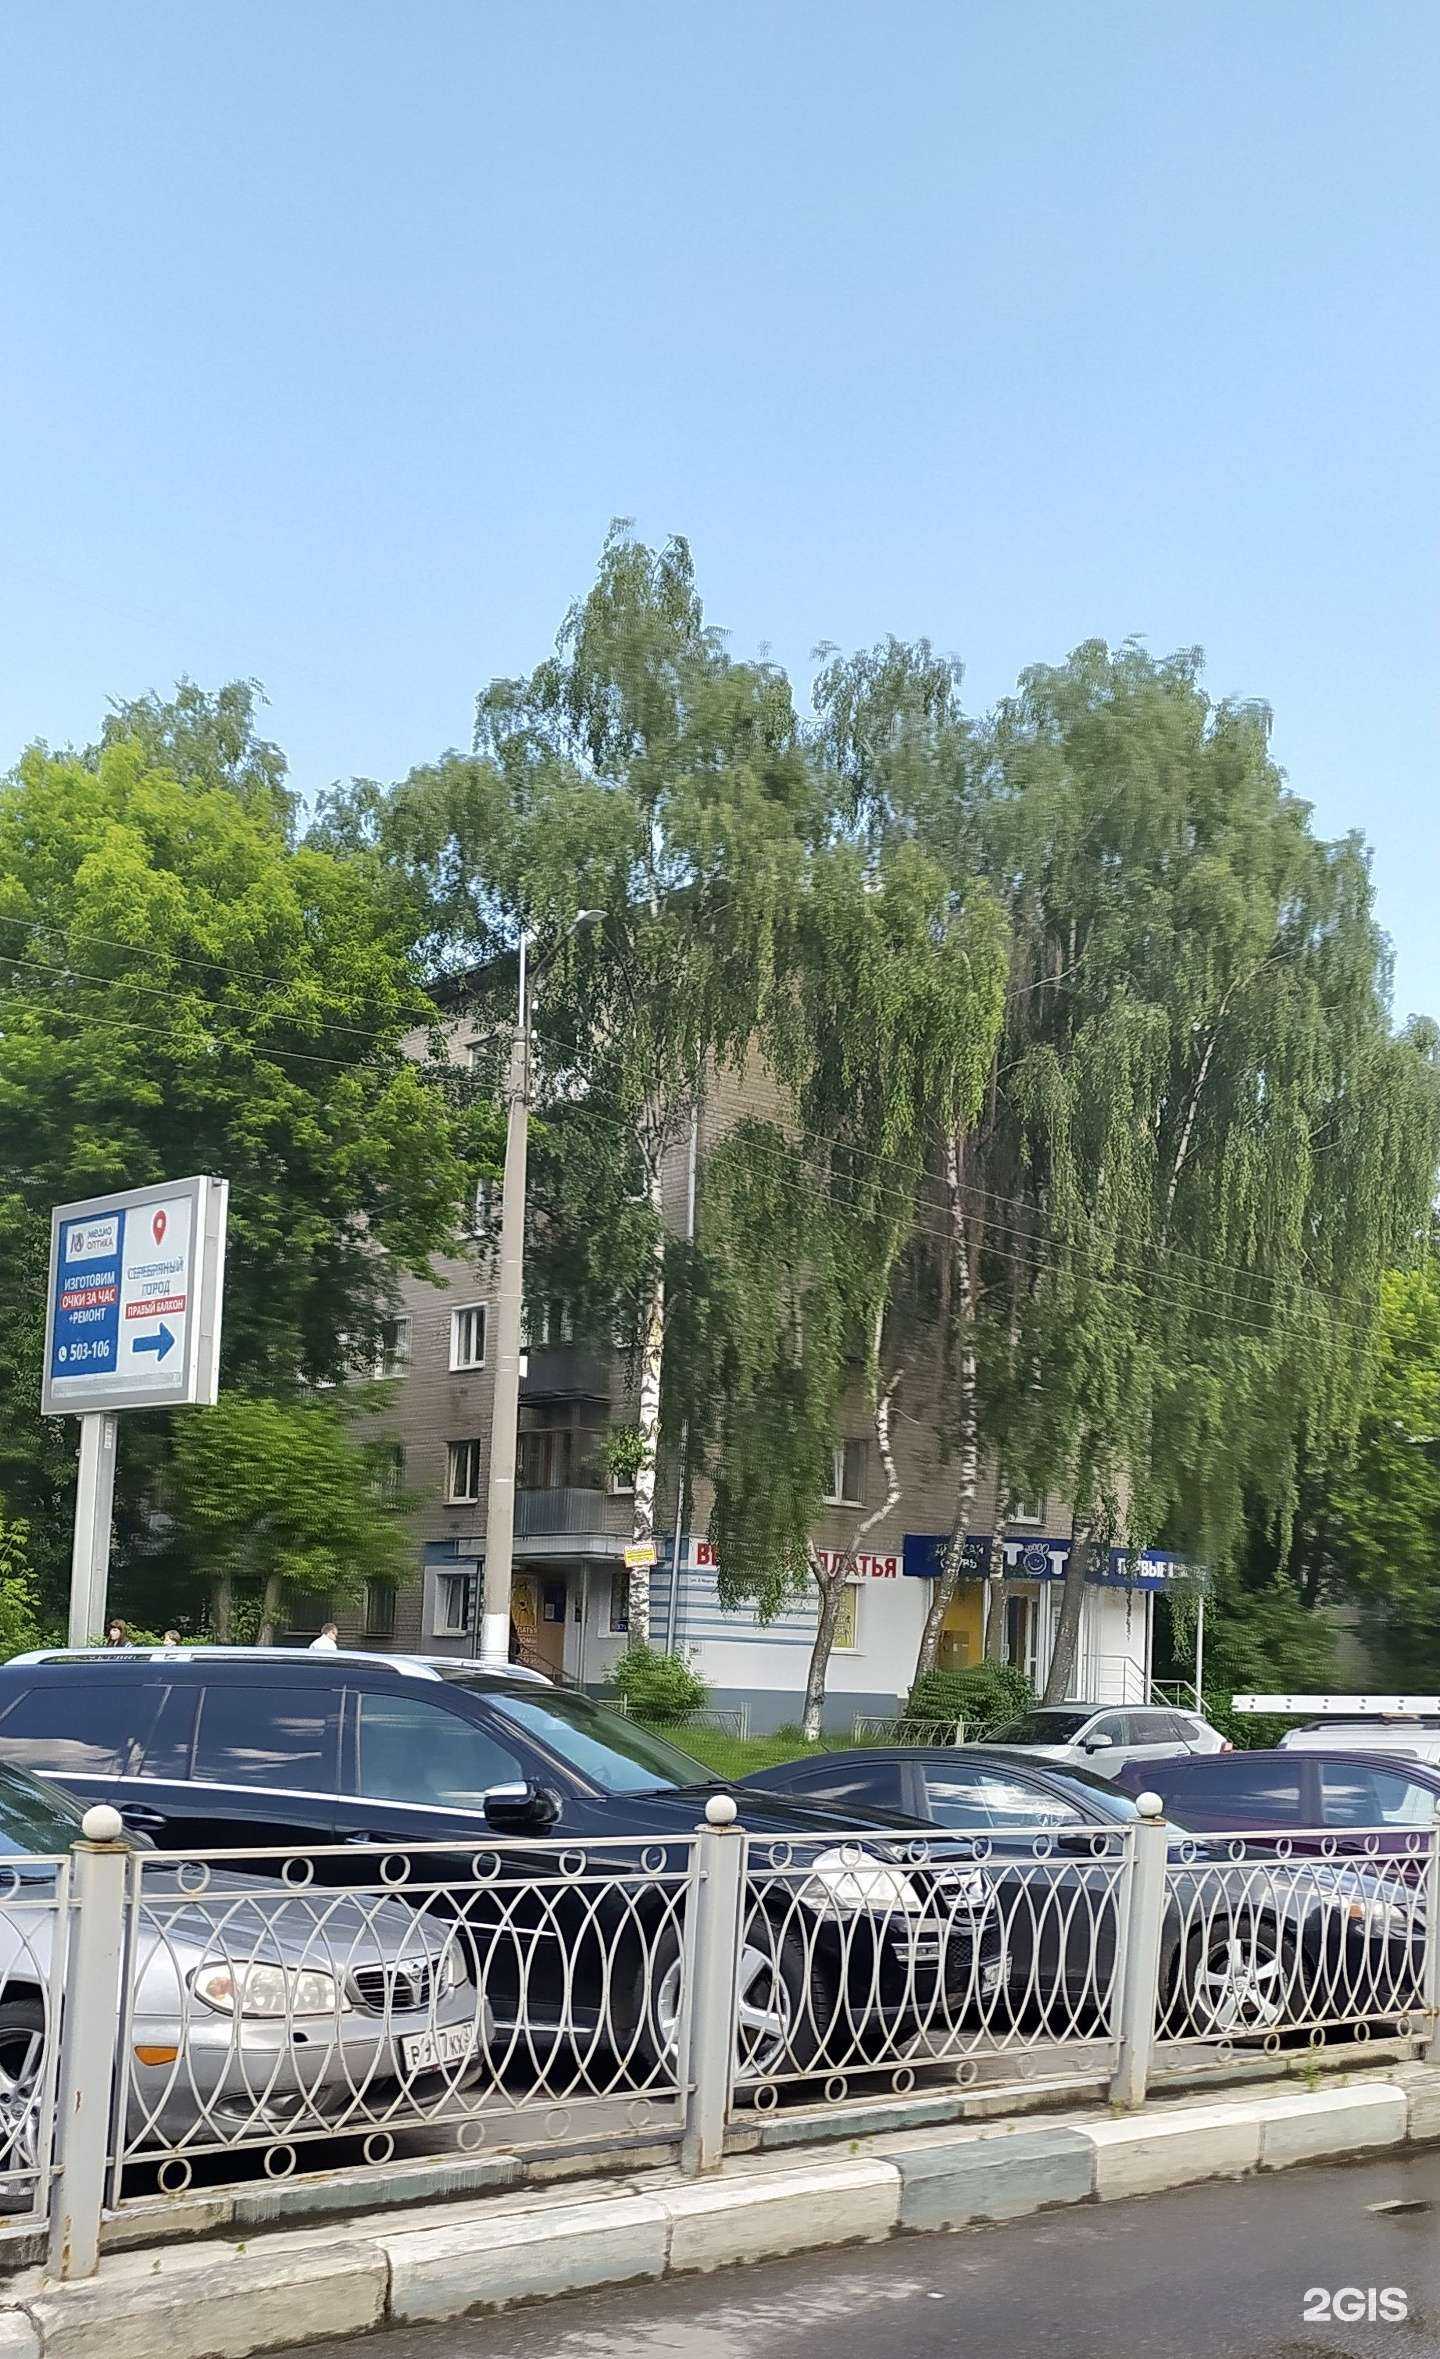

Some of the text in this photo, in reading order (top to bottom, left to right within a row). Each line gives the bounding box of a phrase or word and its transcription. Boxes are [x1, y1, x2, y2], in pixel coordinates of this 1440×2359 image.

[87, 1239, 113, 1250] ОПТИКА
[64, 1271, 115, 1291] ИЗГОТОВИМ
[141, 1280, 170, 1297] ГОРОД
[62, 1288, 115, 1308] ОЧКИ ЗА ЧАС
[127, 1298, 184, 1317] ПРАВЫЙ БАЛКОН
[69, 1339, 110, 1361] 503-106
